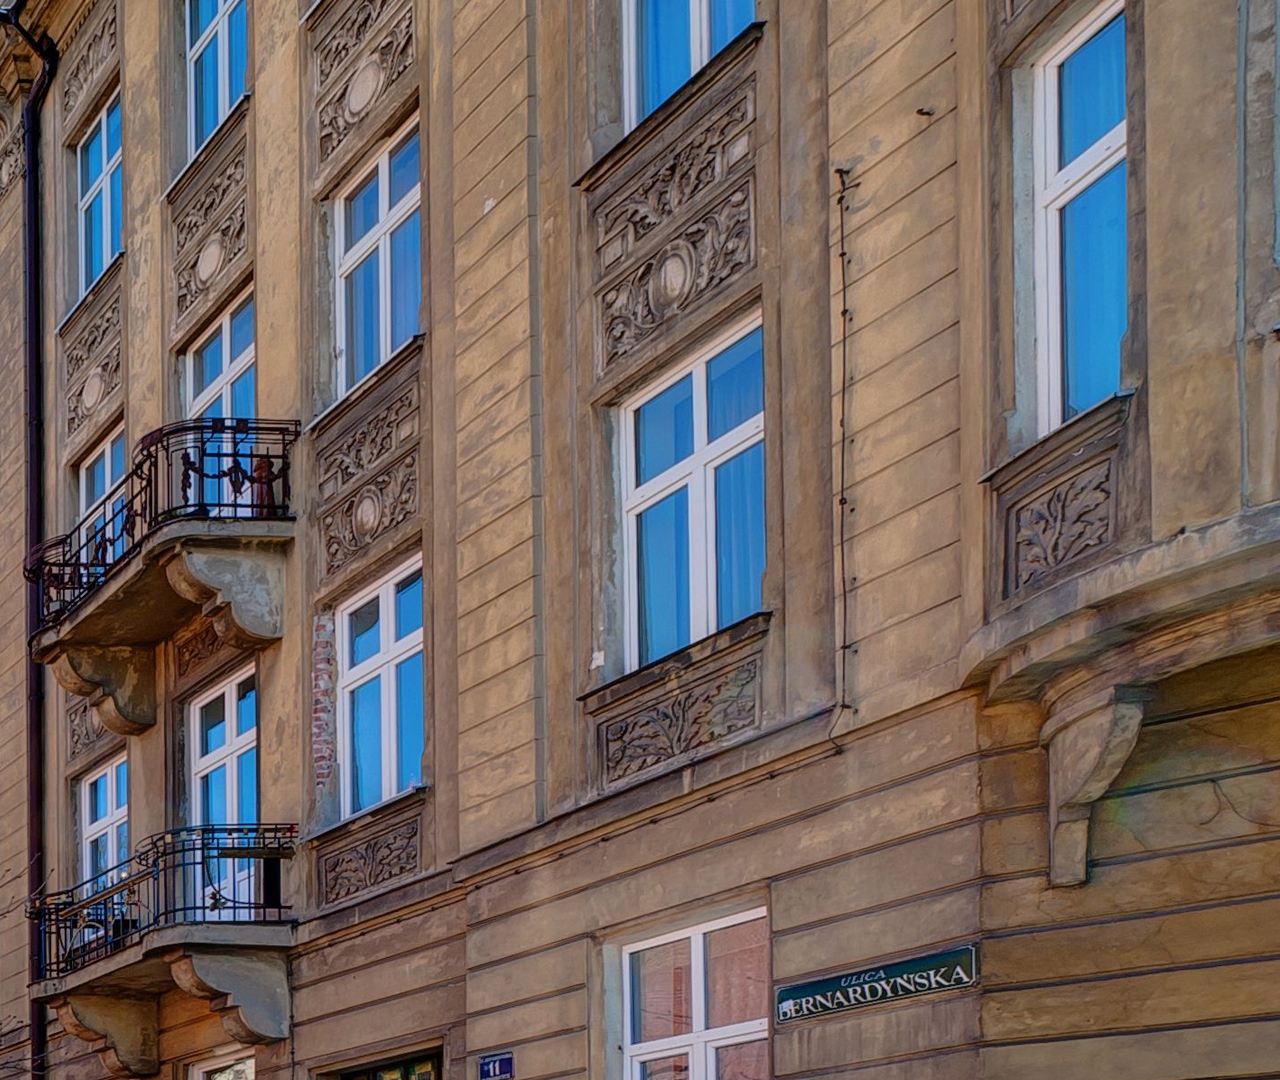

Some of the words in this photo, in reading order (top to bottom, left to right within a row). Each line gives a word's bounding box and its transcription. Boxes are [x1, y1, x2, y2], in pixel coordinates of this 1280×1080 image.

[841, 970, 886, 986] ULICA
[778, 965, 970, 1020] BERNARDYŃSKA
[488, 1060, 500, 1077] 11
